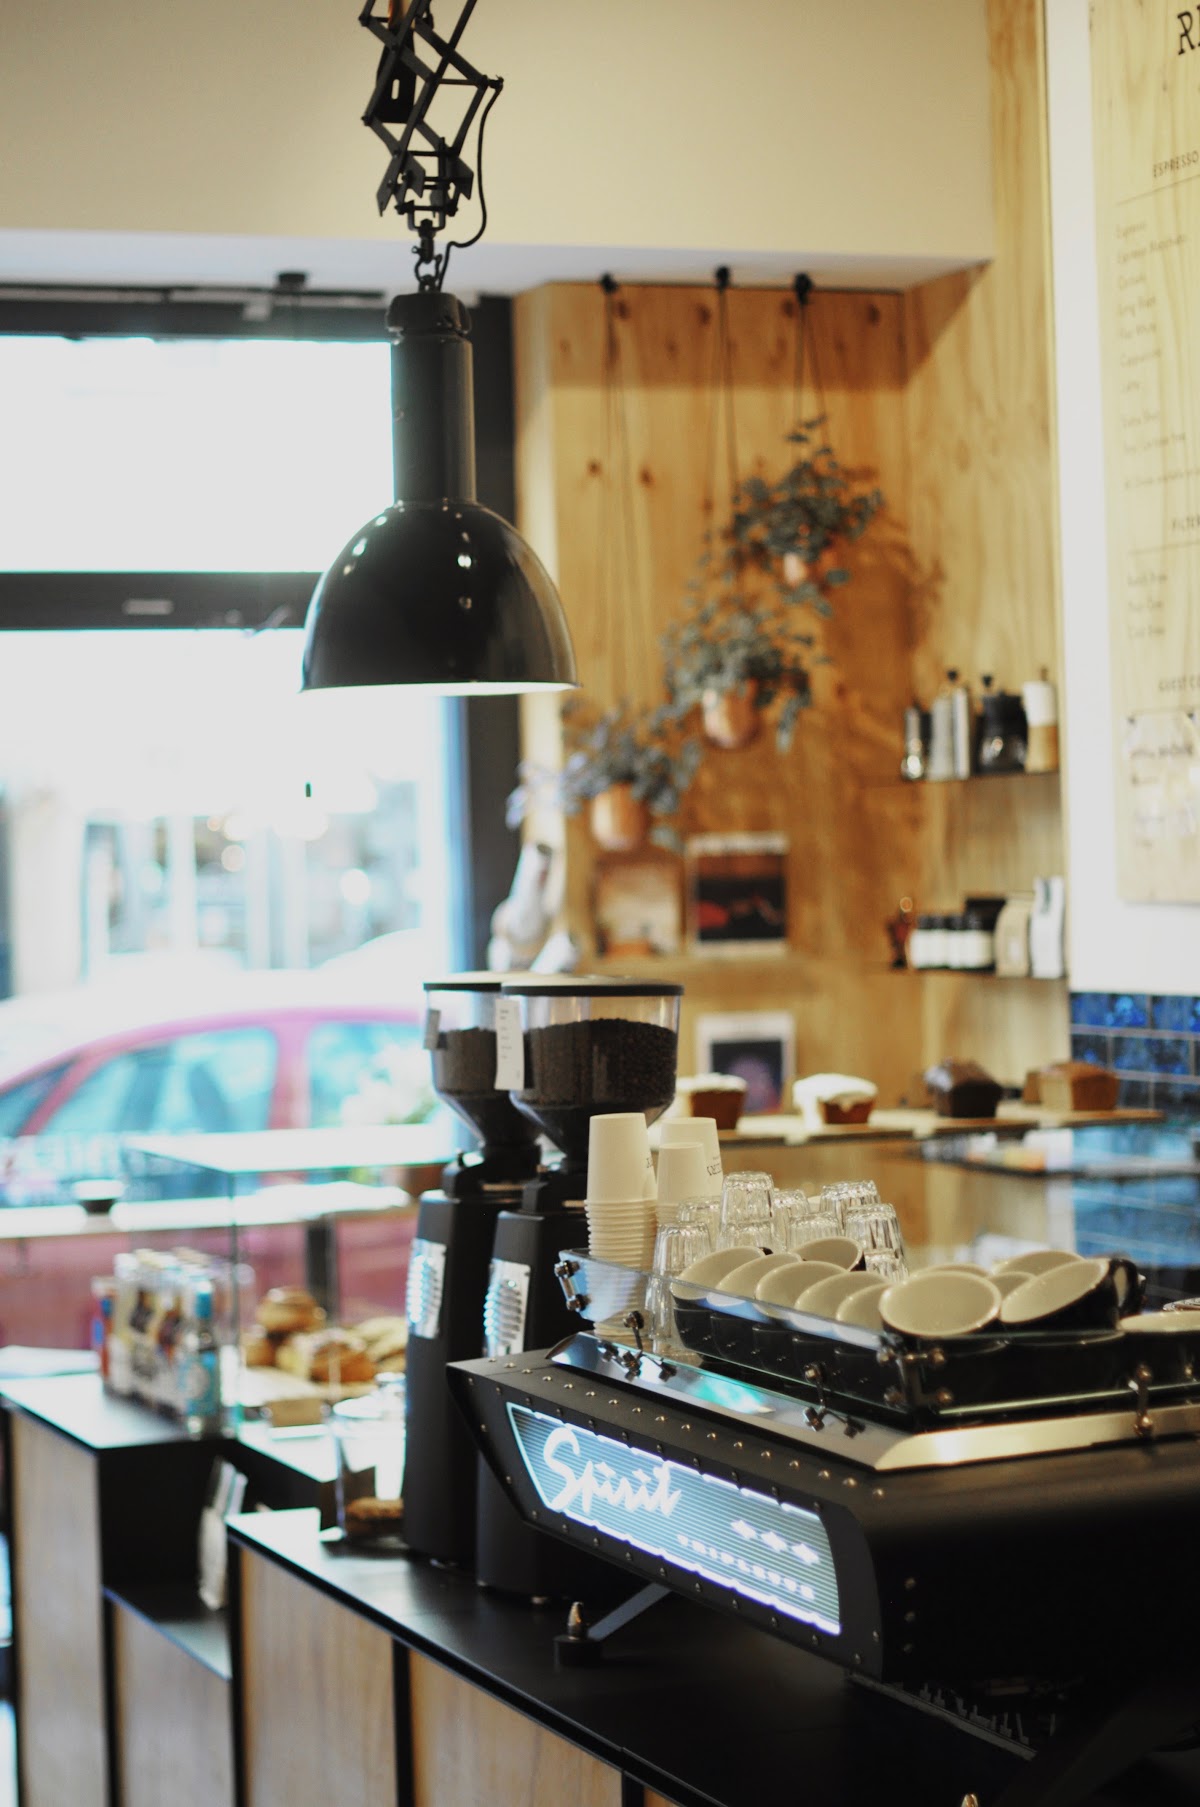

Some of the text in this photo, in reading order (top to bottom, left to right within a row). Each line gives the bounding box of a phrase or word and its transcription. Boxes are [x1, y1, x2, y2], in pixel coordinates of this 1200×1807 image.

[1177, 4, 1200, 55] R
[1153, 150, 1199, 179] ESPRESSO
[543, 1426, 682, 1517] Spirit
